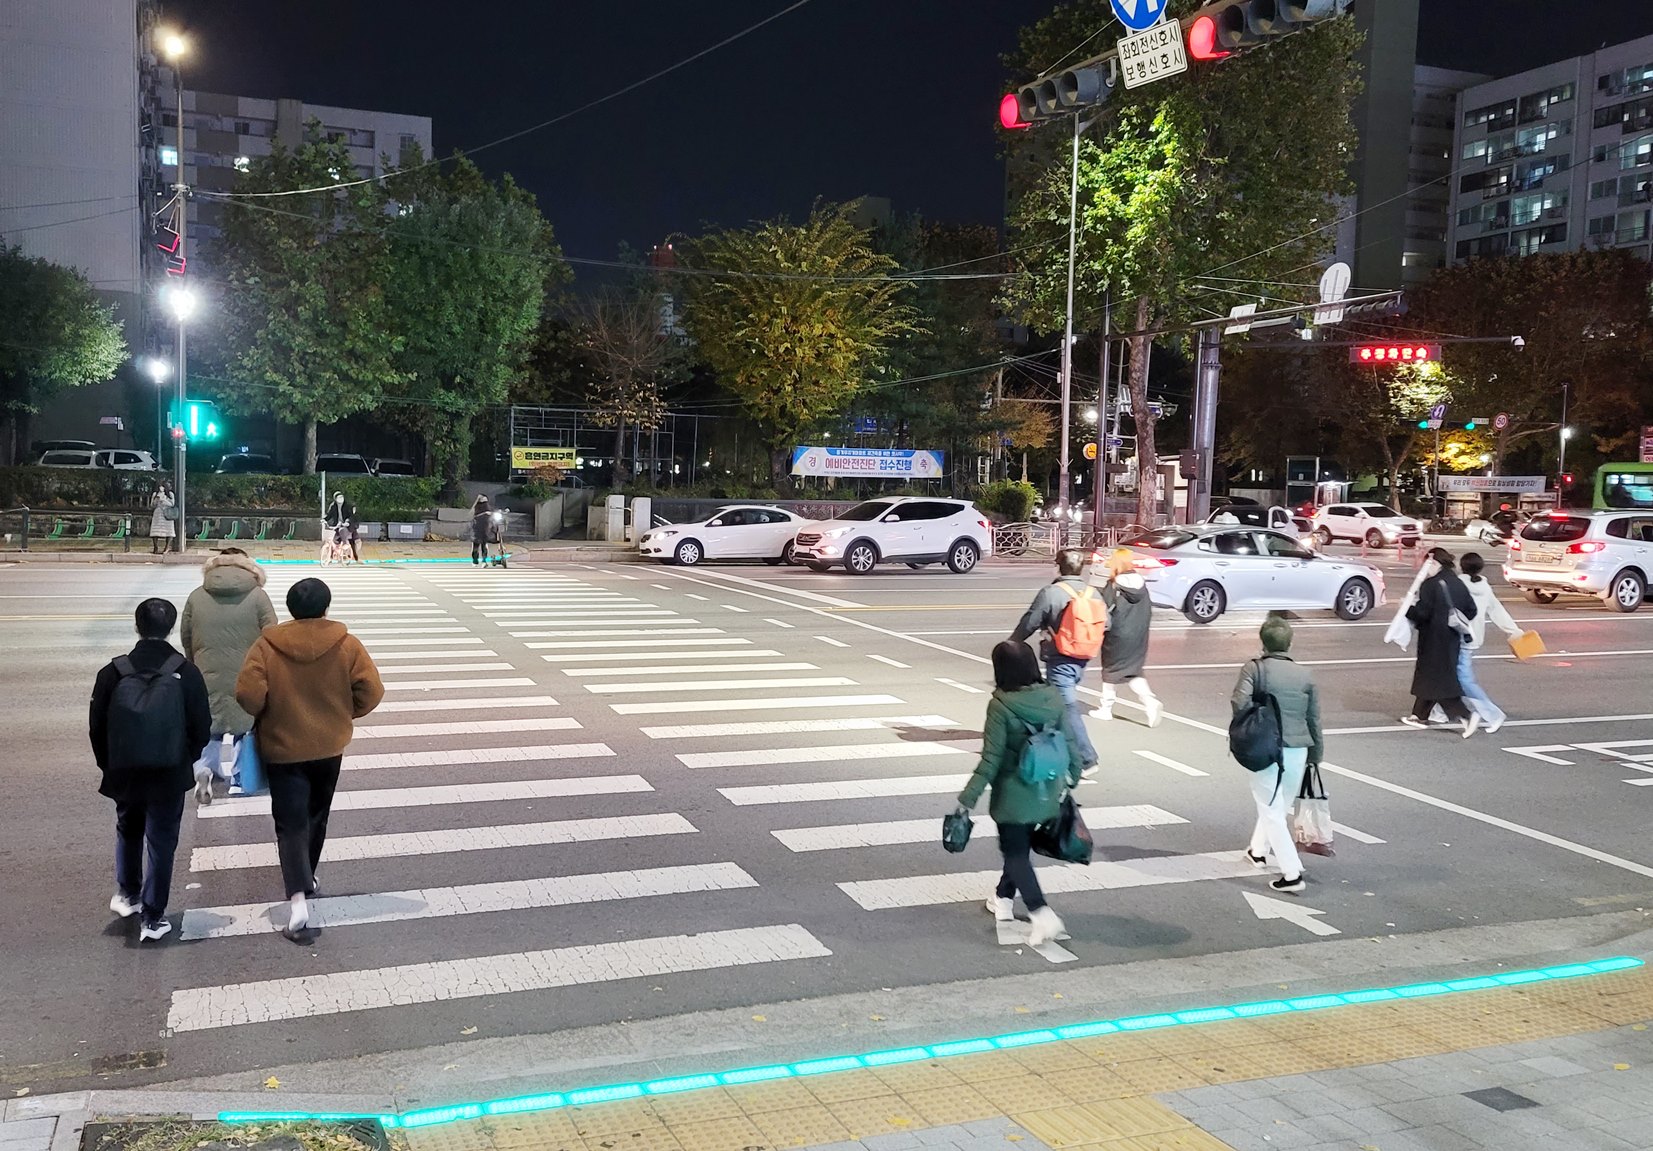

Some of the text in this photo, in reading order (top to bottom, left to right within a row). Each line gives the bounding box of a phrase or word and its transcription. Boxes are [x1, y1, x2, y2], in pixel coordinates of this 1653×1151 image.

[1122, 25, 1179, 60] 좌회전신호시
[1126, 48, 1183, 81] 보행신호시
[1497, 417, 1506, 426] 50
[808, 456, 817, 467] 경
[825, 457, 876, 470] 예비안전진단
[879, 459, 912, 471] 접수진행
